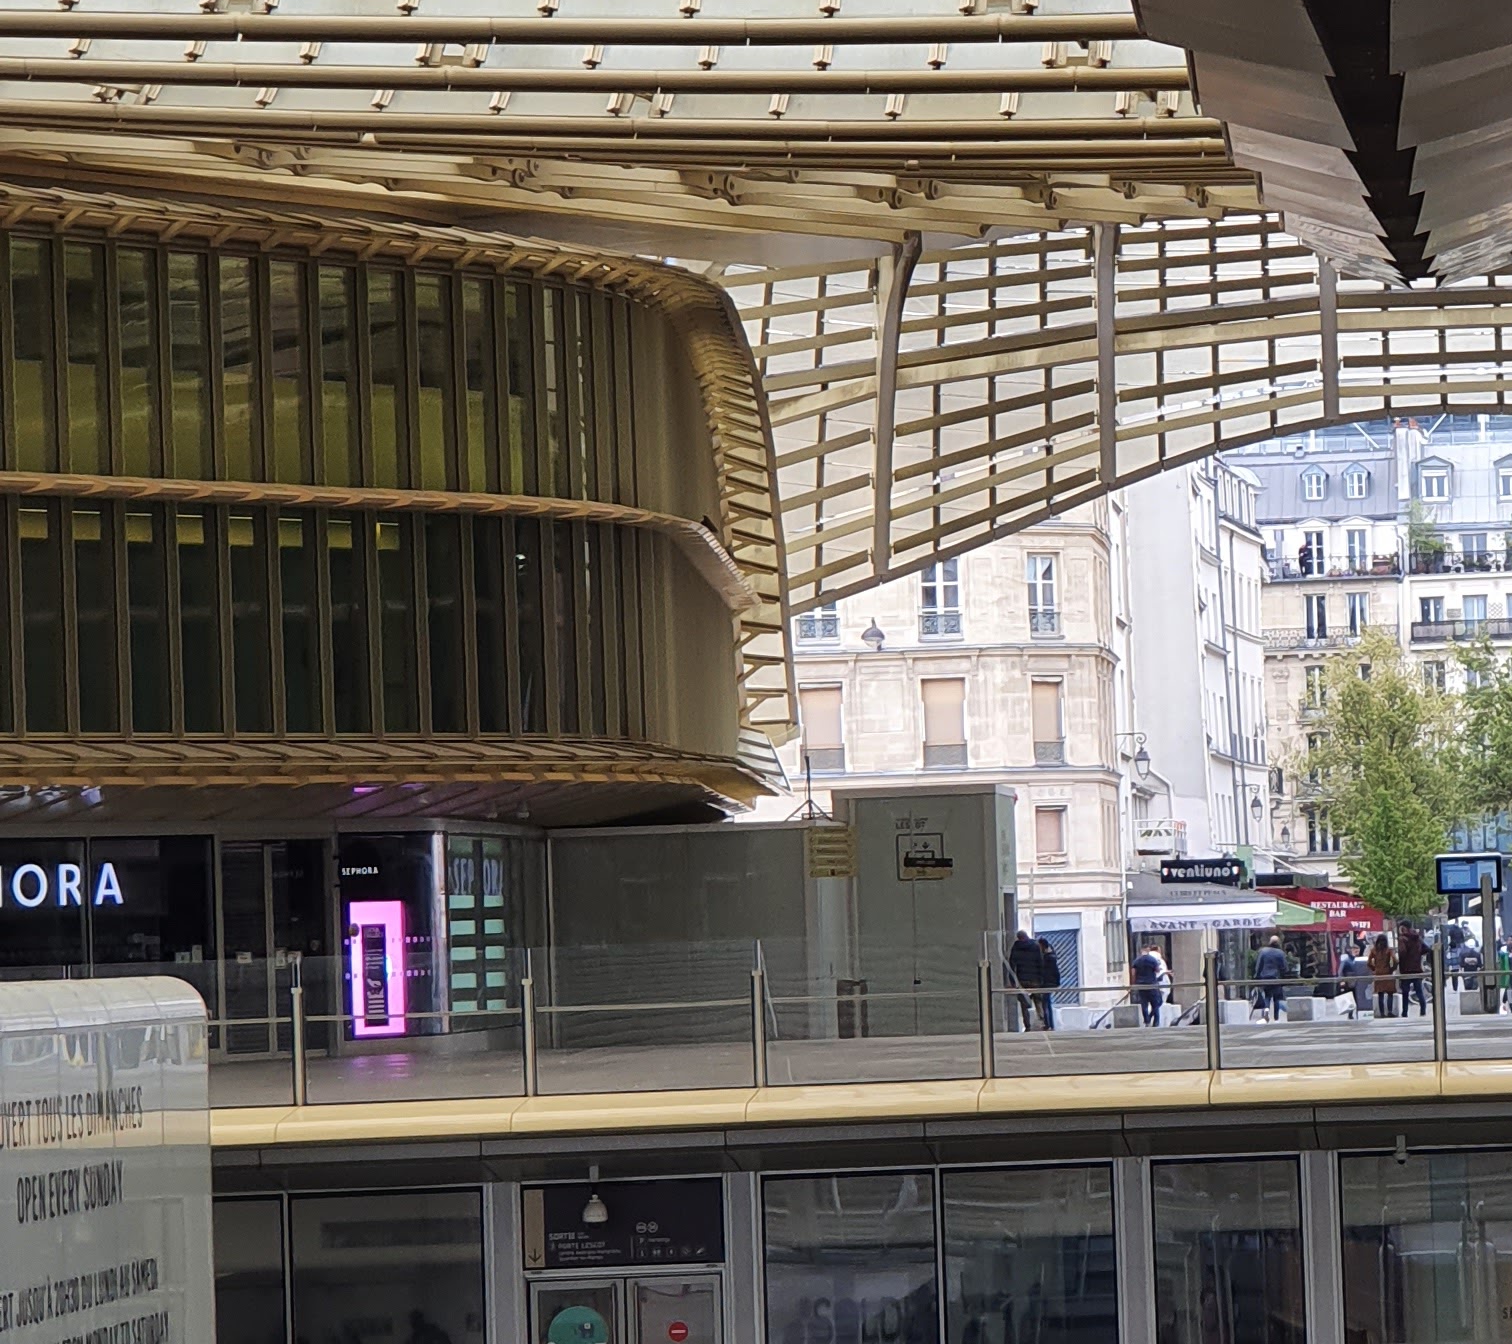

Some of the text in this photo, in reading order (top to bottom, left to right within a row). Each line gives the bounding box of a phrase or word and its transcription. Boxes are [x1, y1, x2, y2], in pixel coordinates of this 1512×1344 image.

[341, 866, 379, 876] SEPHORA
[1170, 864, 1231, 878] ventiuno
[0, 862, 124, 908] ORA
[1329, 909, 1347, 918] BAR
[1150, 920, 1201, 930] AVANT
[1212, 917, 1262, 929] GARDE
[1350, 920, 1371, 929] WIFI
[35, 1094, 63, 1144] TOUS
[66, 1092, 84, 1140] LES
[86, 1085, 144, 1137] DIMANCHES
[17, 1158, 123, 1224] OPEN EVERY SUNDAY
